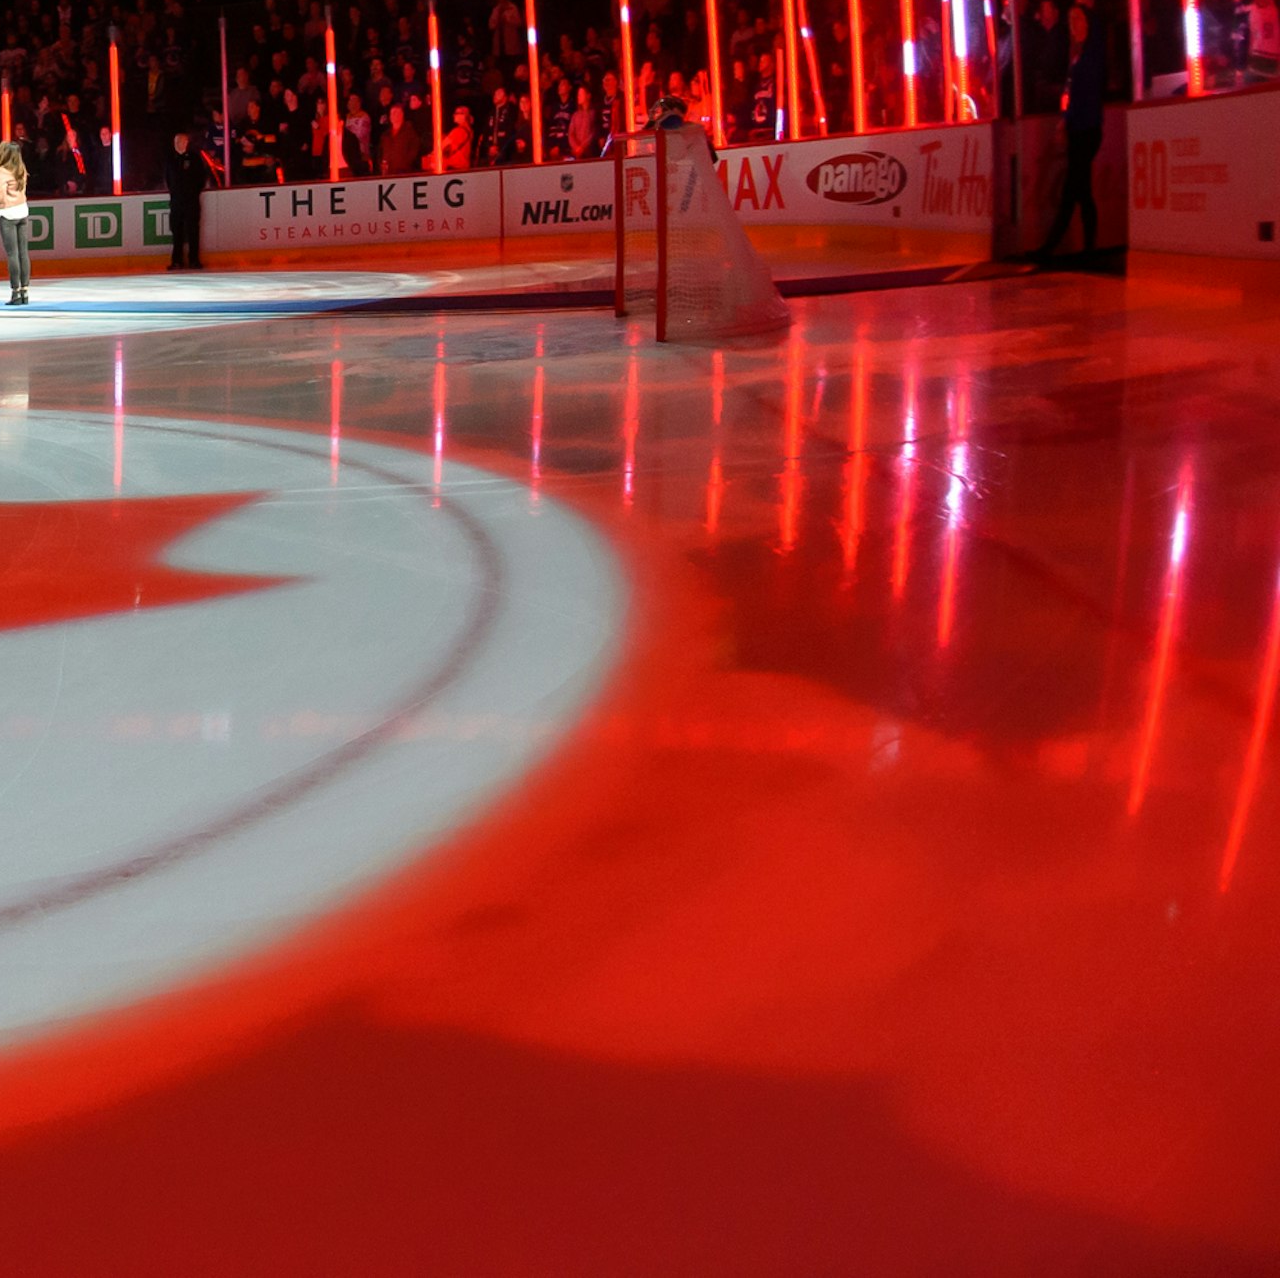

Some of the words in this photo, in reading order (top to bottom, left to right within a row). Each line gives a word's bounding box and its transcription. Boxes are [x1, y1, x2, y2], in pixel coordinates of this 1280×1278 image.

[819, 156, 901, 199] panago
[1133, 139, 1167, 210] 80
[259, 187, 346, 219] THE
[378, 179, 465, 212] KEG
[521, 200, 613, 225] NHL.COM
[79, 211, 117, 240] TD
